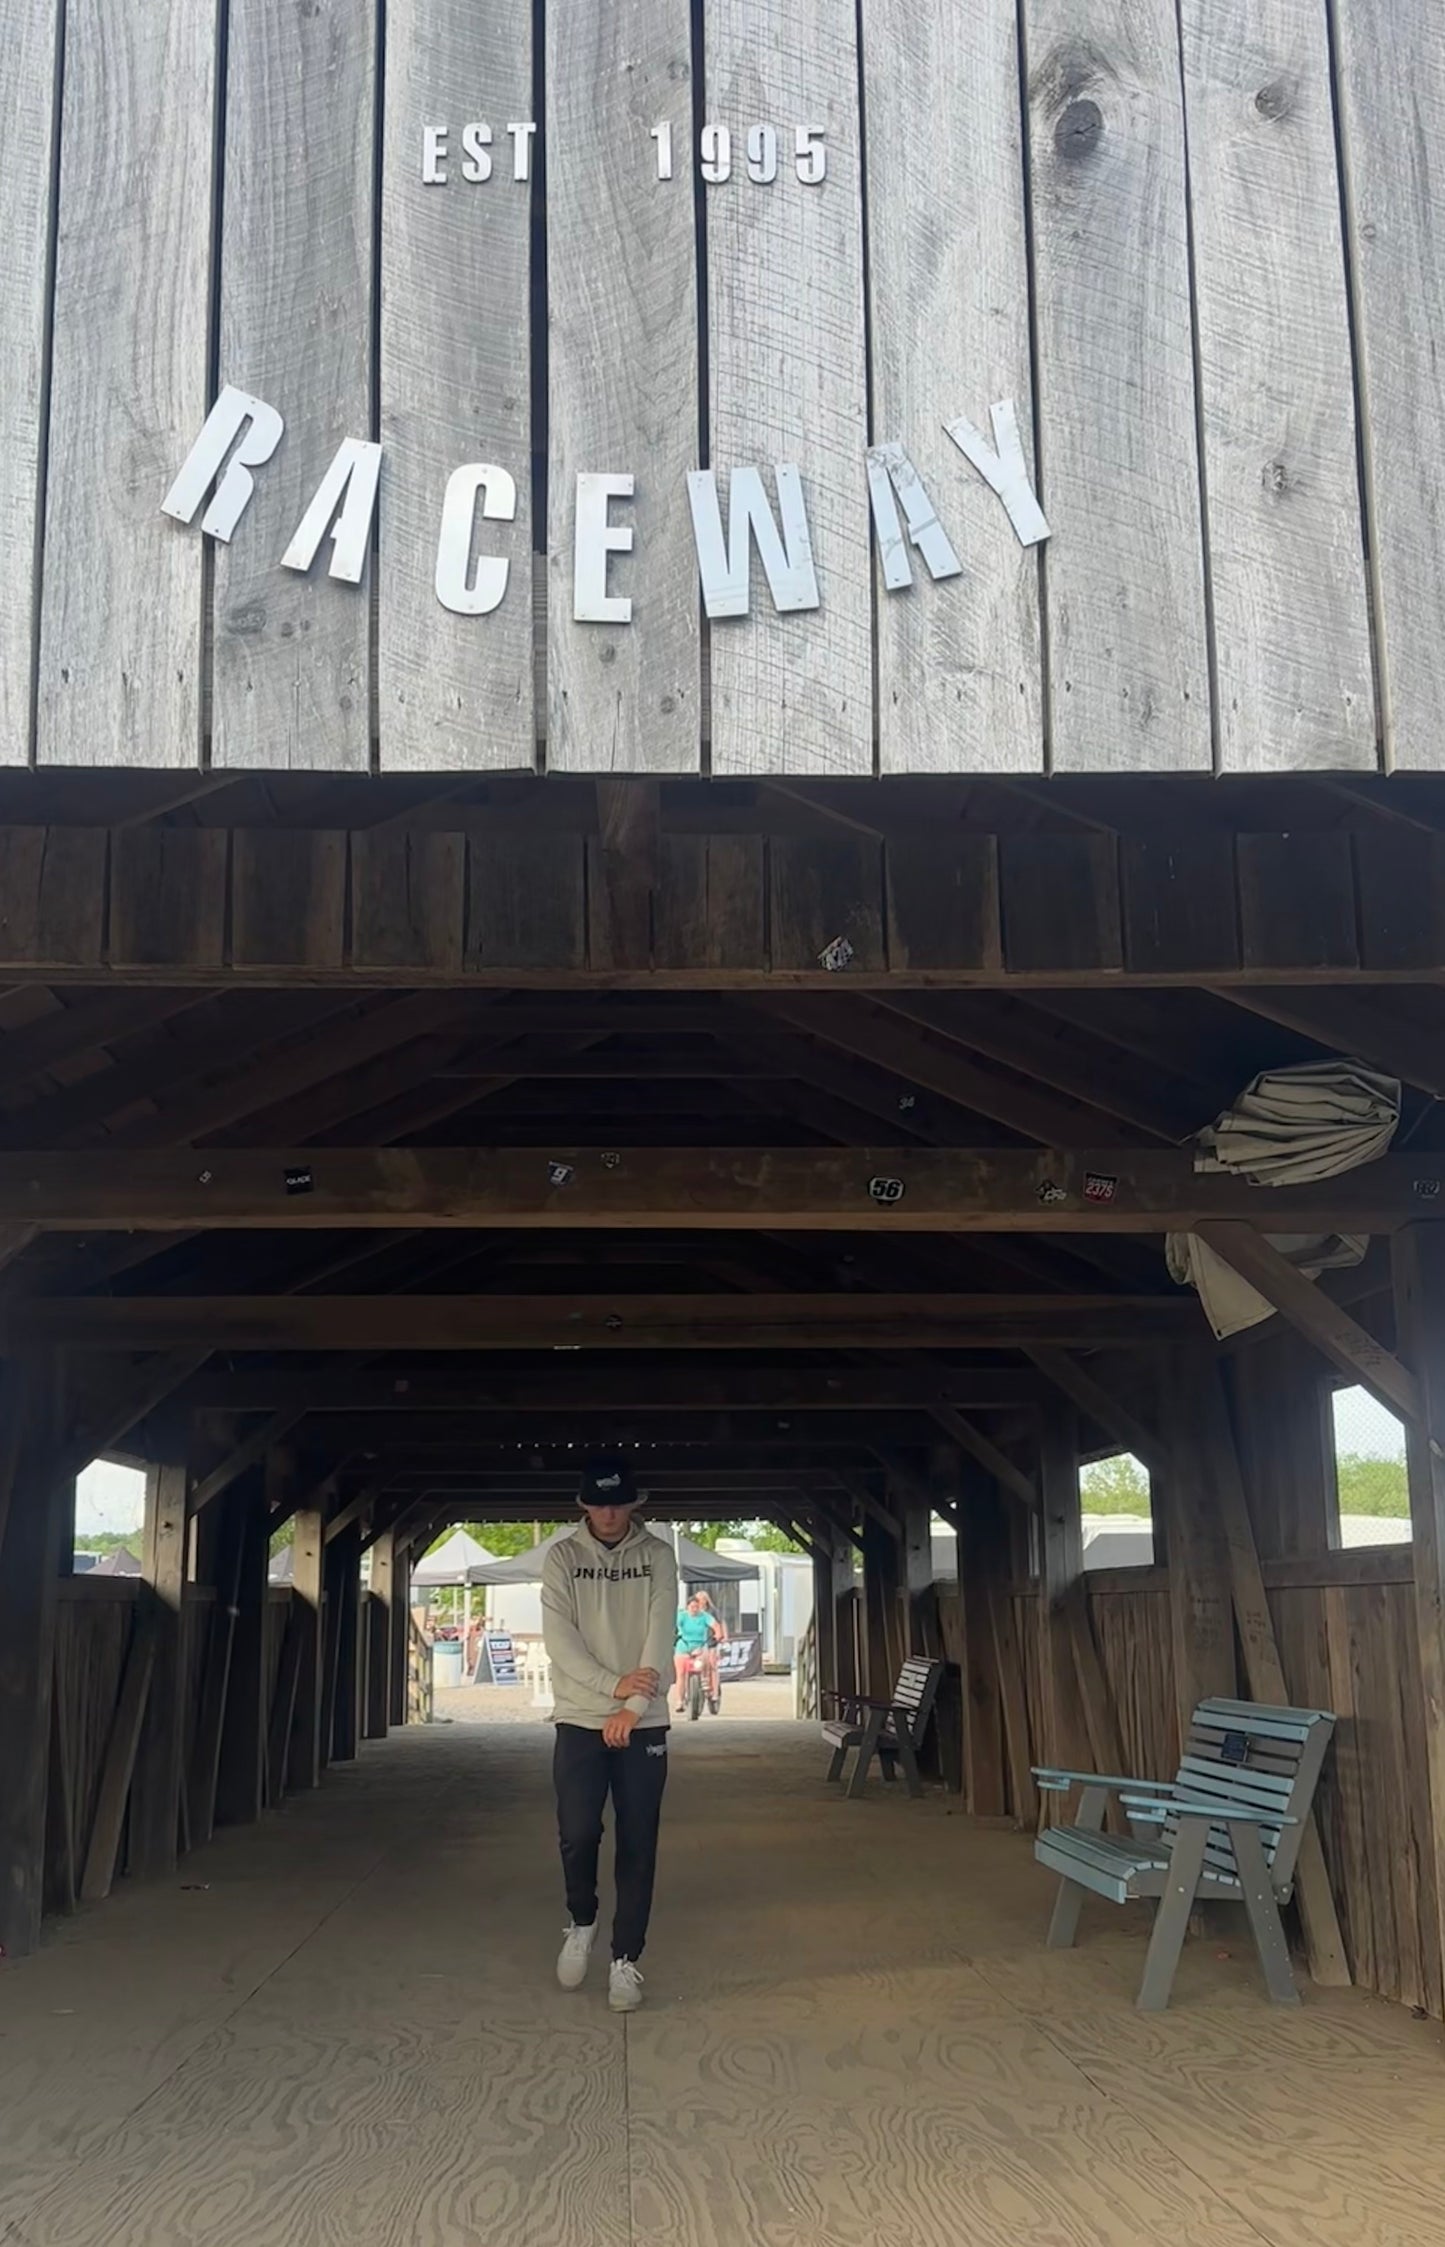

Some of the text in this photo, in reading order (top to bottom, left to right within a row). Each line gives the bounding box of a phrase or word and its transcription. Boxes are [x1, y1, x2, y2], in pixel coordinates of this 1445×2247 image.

[422, 121, 827, 184] EST 1995
[161, 385, 1052, 623] RACEWAY
[872, 1180, 901, 1198] 56
